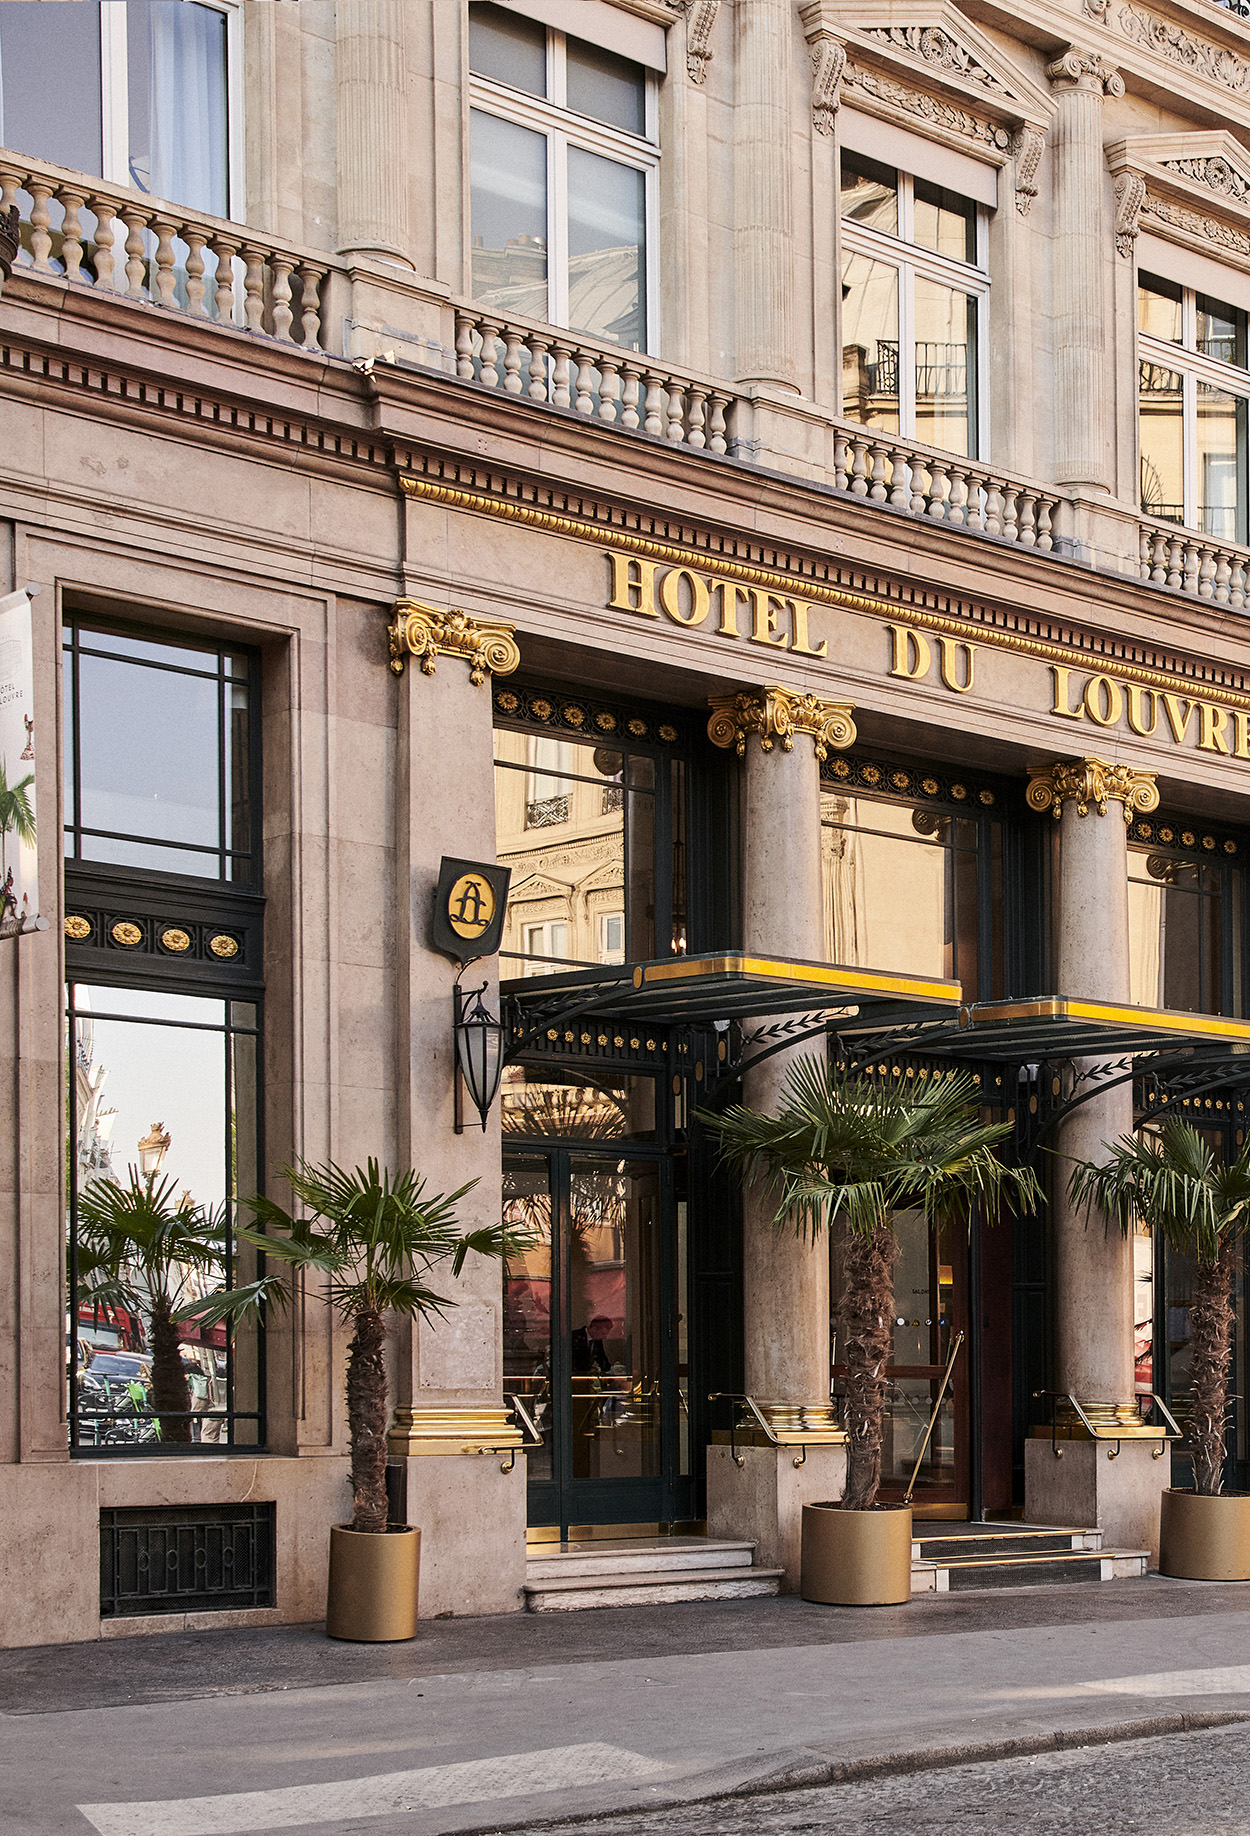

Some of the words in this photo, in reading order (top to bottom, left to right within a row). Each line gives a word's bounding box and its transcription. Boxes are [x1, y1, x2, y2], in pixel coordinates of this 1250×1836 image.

[606, 551, 828, 658] HOTEL
[888, 624, 979, 693] DU
[0, 684, 15, 694] ÔTEL
